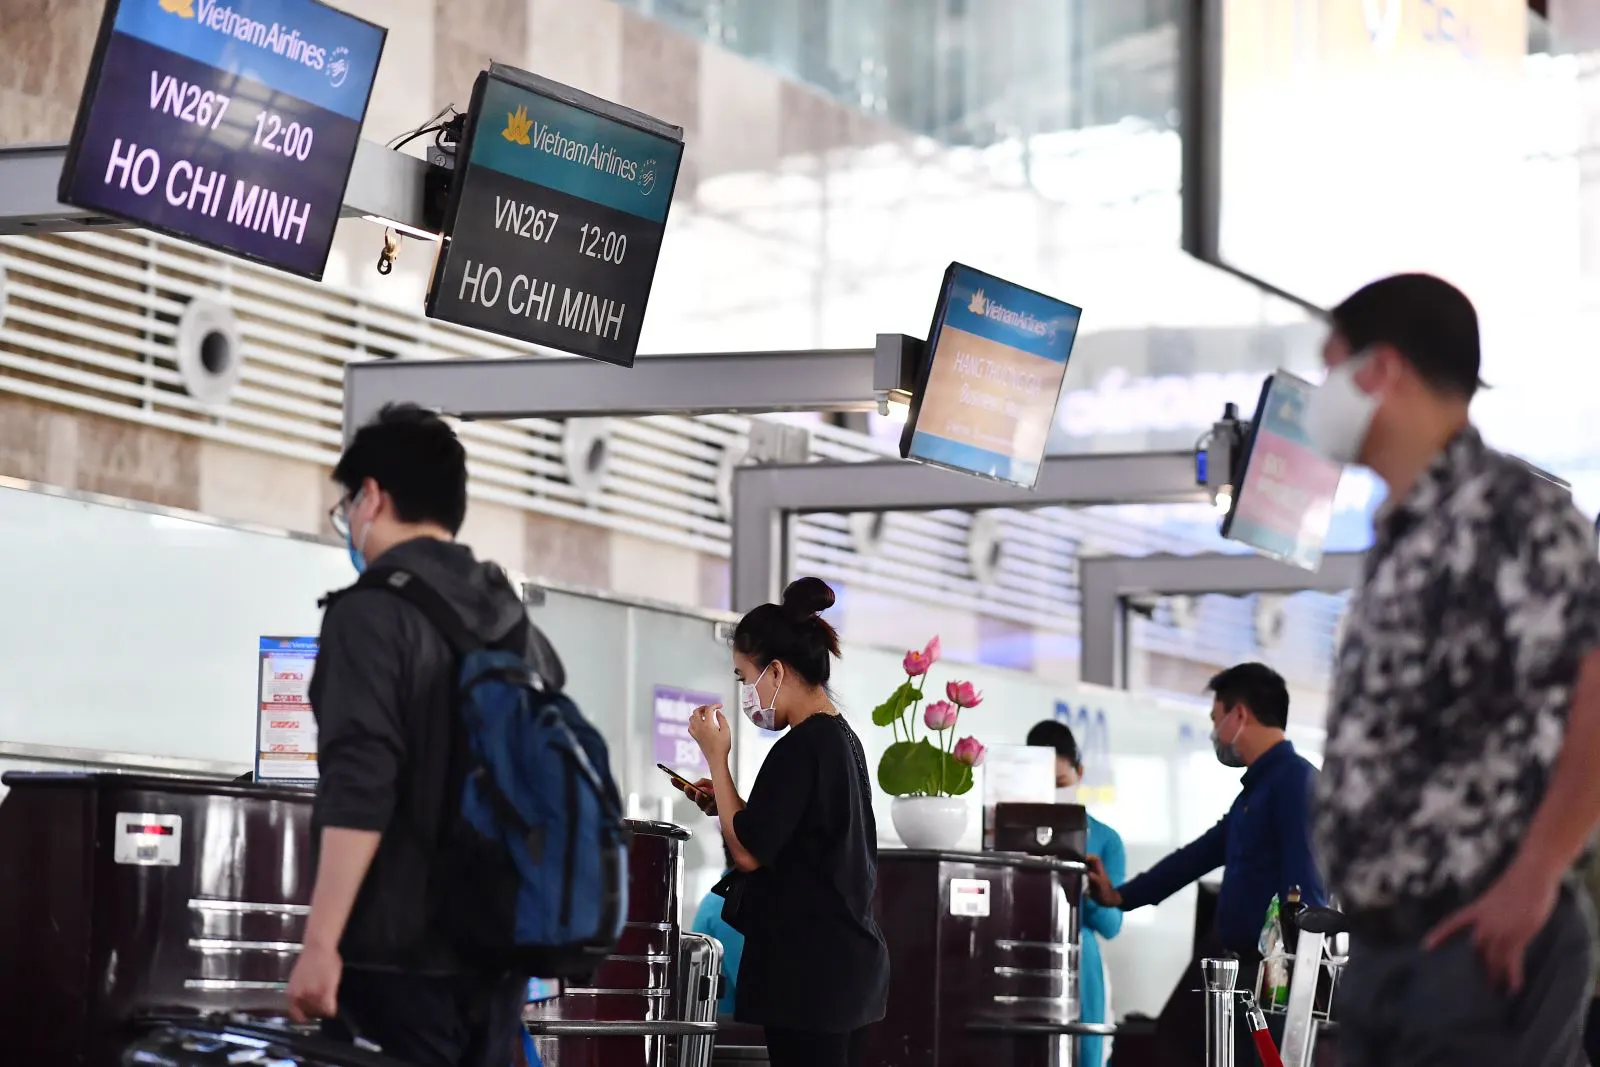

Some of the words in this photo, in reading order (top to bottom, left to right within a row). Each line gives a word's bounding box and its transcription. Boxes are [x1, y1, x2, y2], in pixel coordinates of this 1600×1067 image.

[150, 70, 231, 131] VN267
[253, 110, 314, 162] 12:00
[104, 138, 161, 196] HO
[165, 159, 227, 218] CHI
[226, 179, 312, 245] MINH
[494, 195, 560, 244] VN267
[578, 223, 628, 265] 12:00
[458, 259, 503, 308] HO
[507, 274, 556, 323] CHI
[557, 287, 626, 341] MINH
